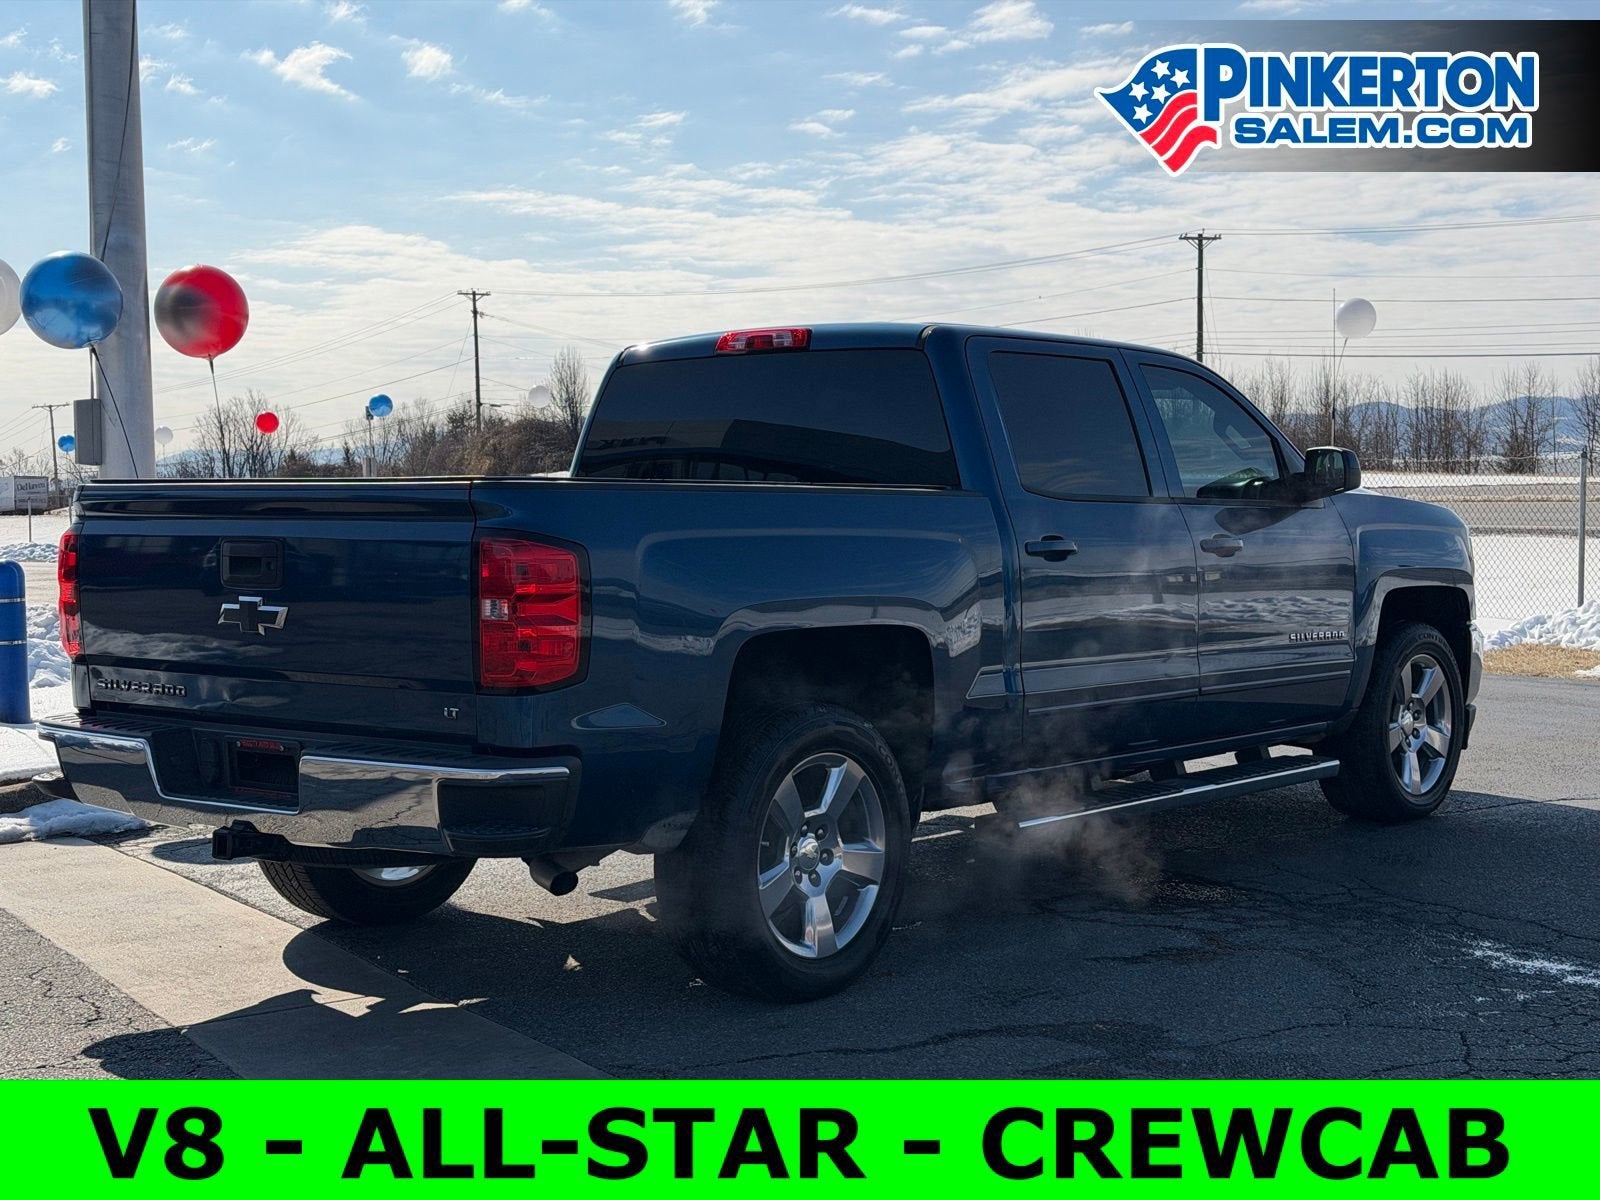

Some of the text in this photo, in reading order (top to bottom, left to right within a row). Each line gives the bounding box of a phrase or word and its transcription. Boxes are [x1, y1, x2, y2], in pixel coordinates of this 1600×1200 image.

[1289, 630, 1346, 643] SILVERADO
[97, 678, 187, 697] SILVERADO
[444, 707, 460, 720] LT
